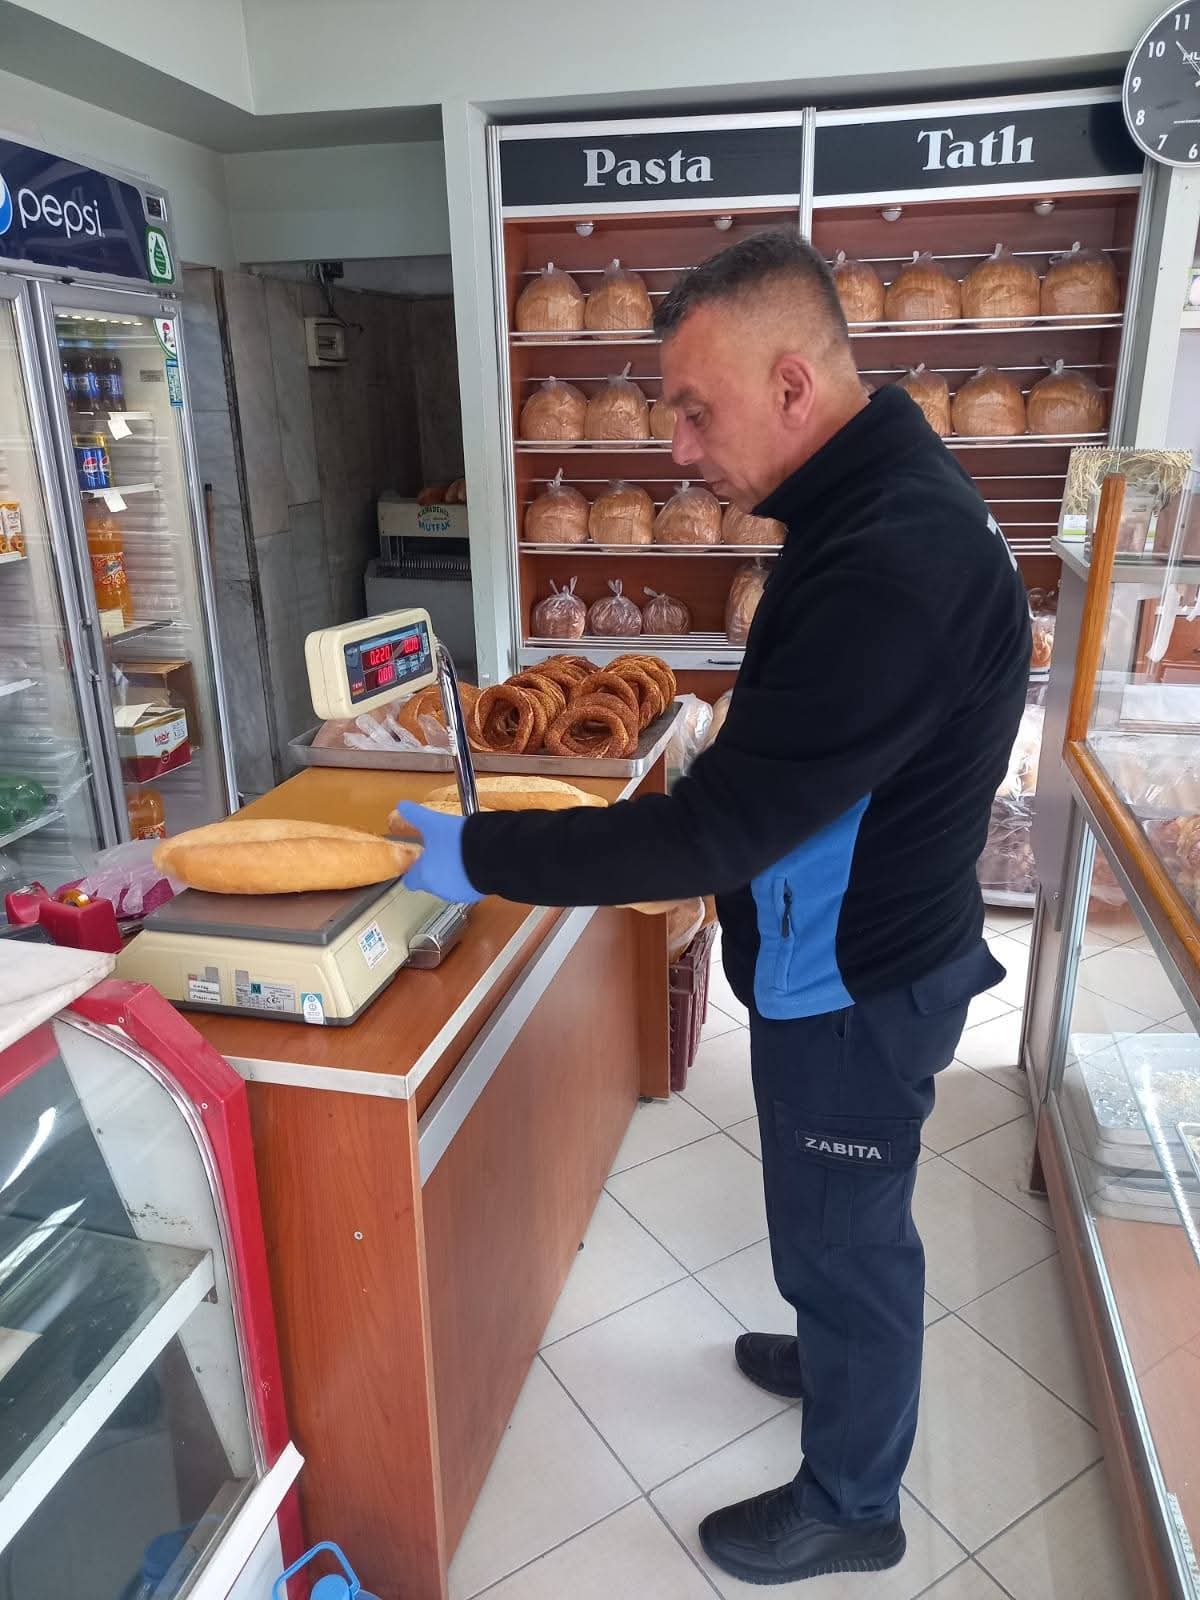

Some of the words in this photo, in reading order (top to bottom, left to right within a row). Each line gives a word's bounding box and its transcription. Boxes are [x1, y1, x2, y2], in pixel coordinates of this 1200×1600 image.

[1174, 13, 1191, 31] 11
[1148, 41, 1166, 58] 10
[1132, 76, 1142, 93] 9
[1135, 109, 1146, 126] 8
[917, 124, 1035, 171] Tatlı
[1157, 134, 1168, 151] 7
[1188, 143, 1198, 159] 6
[583, 148, 714, 187] Pasta
[18, 188, 102, 239] pepsi
[804, 1136, 882, 1160] ZABITA
